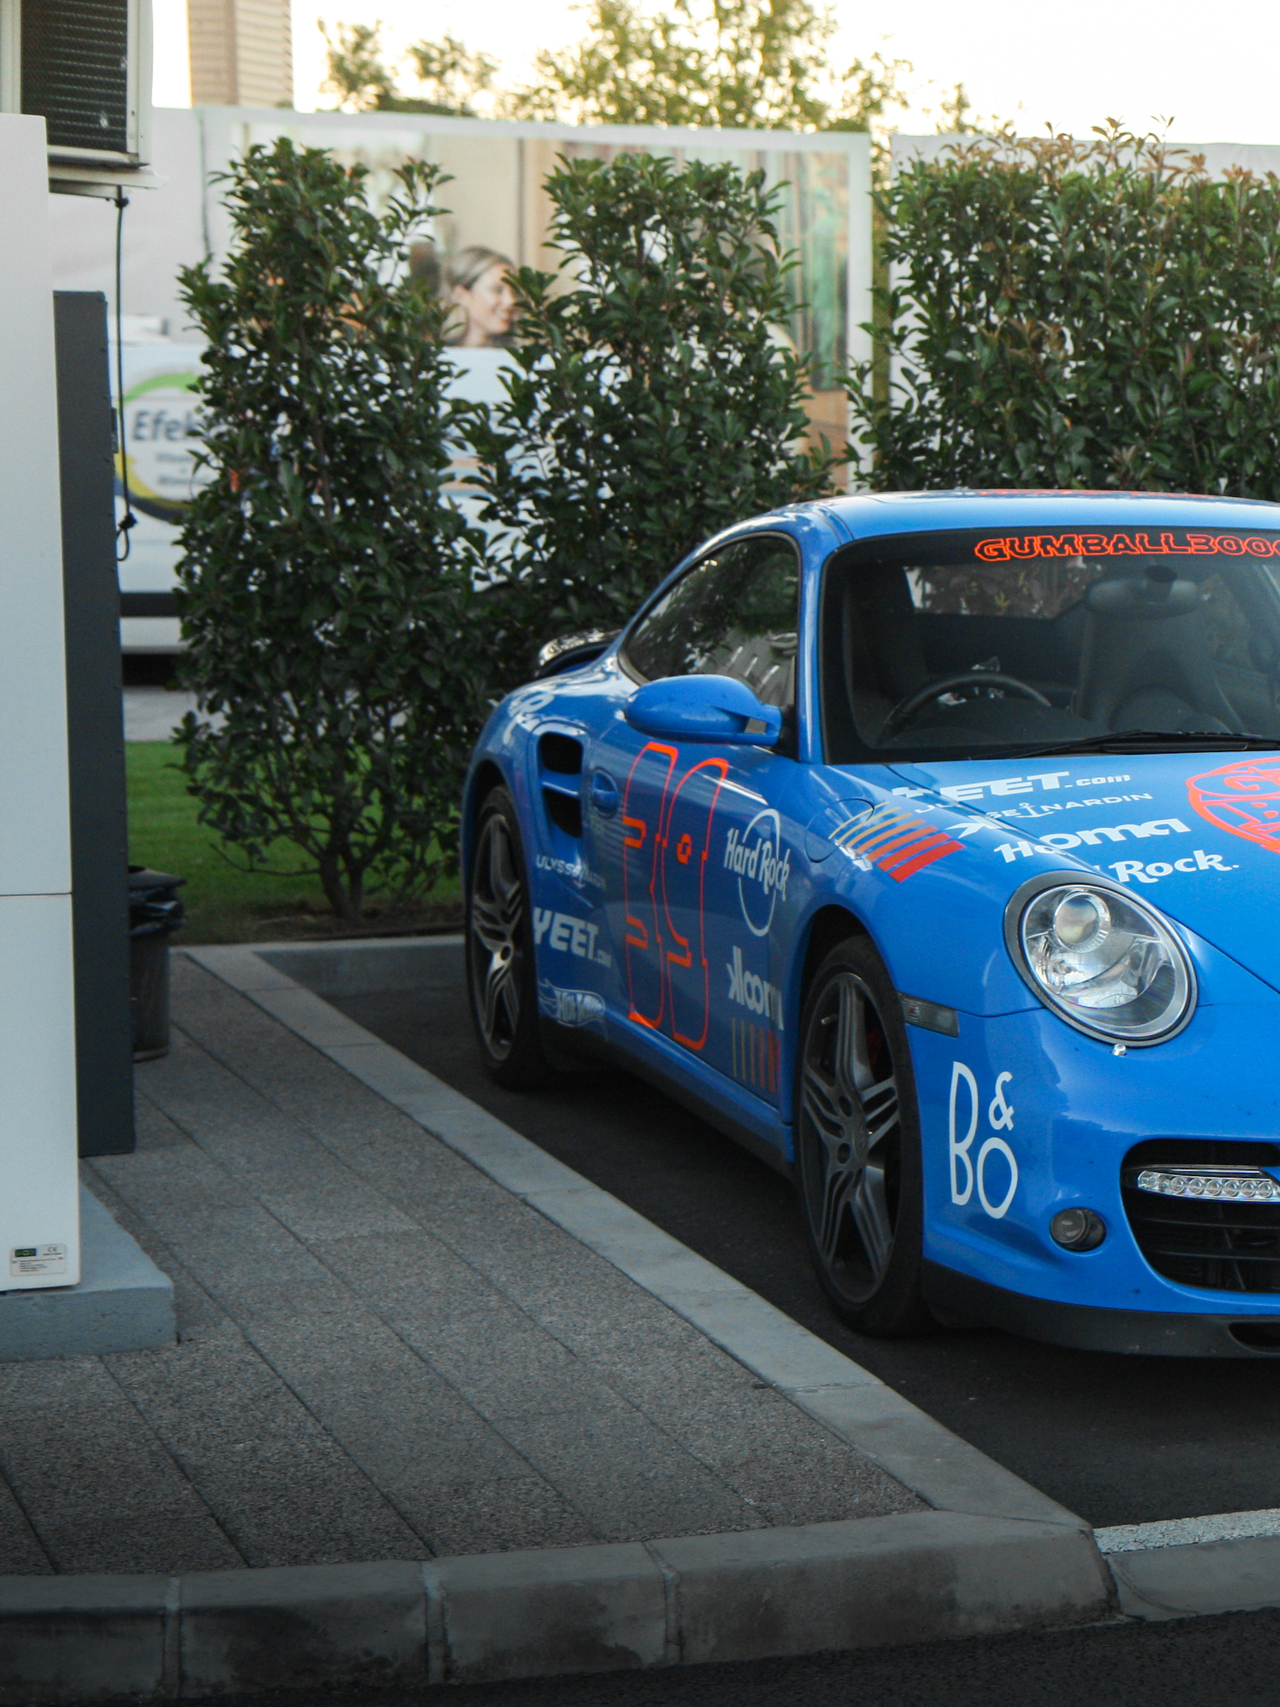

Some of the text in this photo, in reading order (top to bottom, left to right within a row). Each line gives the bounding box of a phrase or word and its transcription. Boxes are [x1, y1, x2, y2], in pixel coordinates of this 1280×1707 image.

[1046, 792, 1154, 814] NARDIN
[723, 827, 791, 902] Hard Rock
